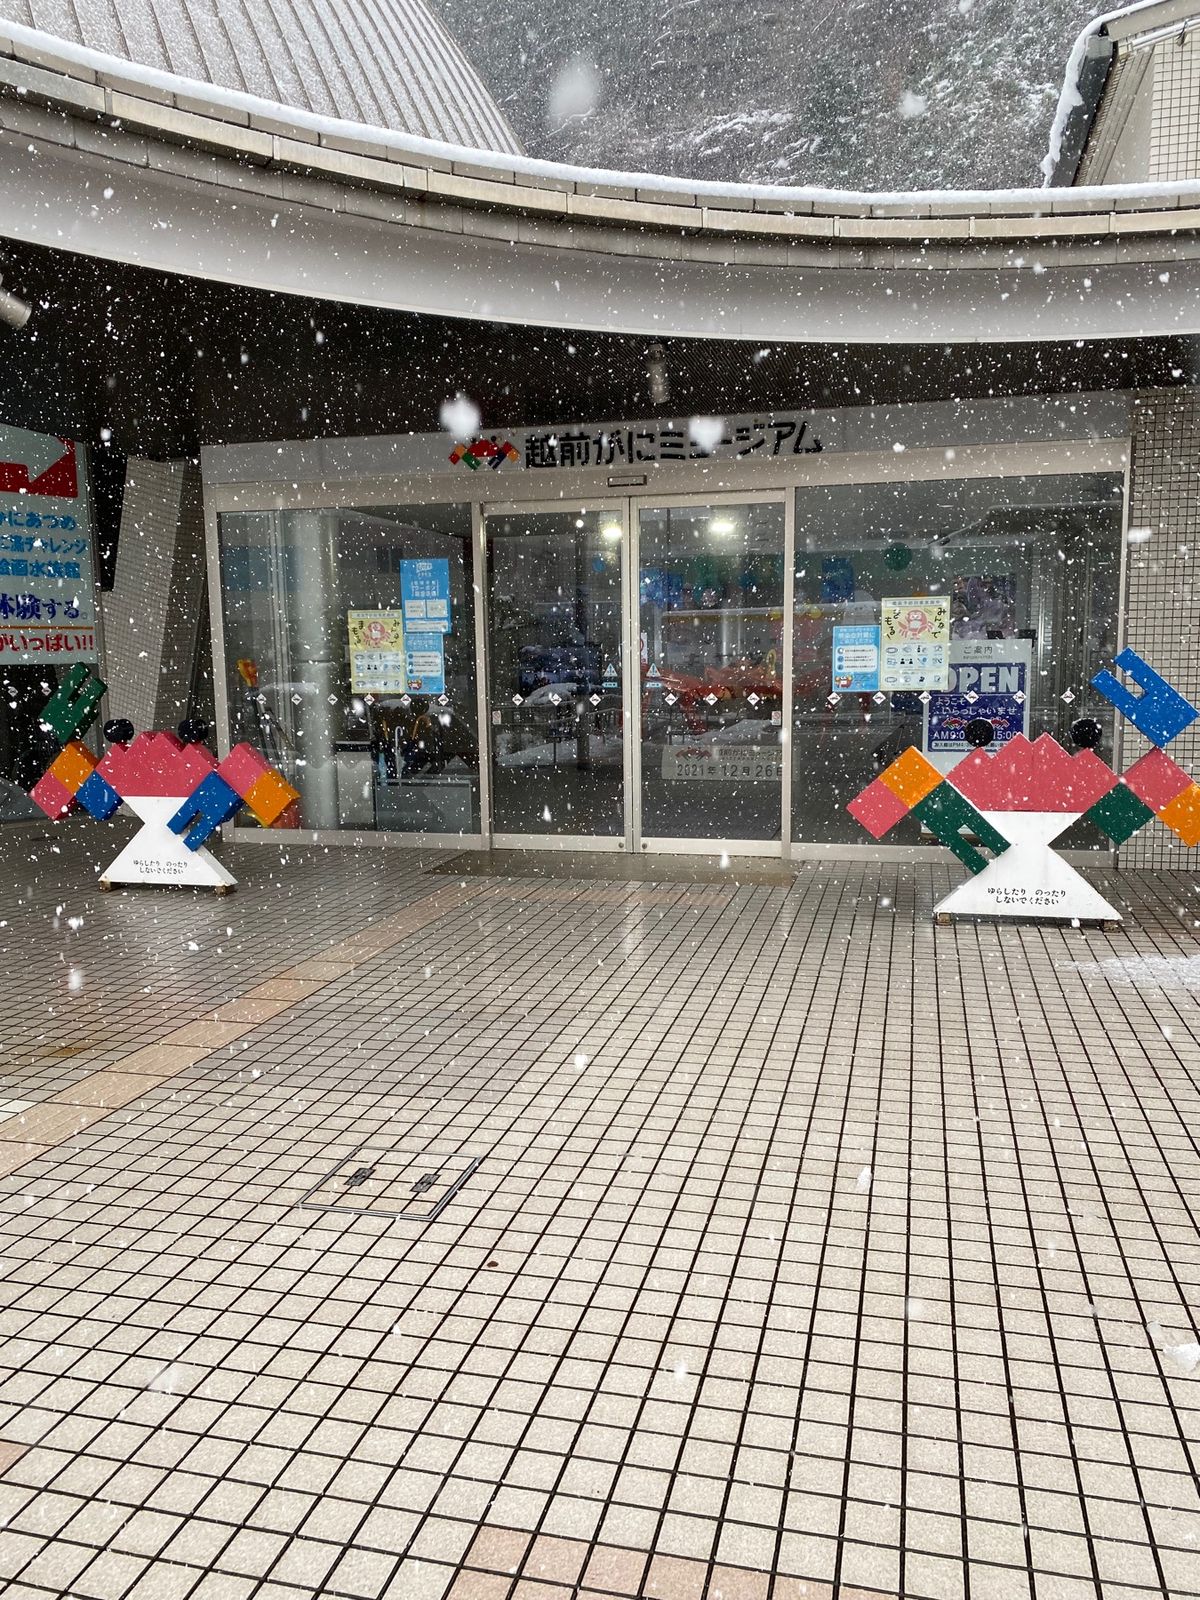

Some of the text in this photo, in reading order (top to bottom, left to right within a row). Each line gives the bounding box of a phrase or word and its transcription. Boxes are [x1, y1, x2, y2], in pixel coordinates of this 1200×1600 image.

[932, 607, 946, 638] みんなで
[963, 645, 993, 655] ご案内
[936, 698, 966, 706] ようこそ
[942, 706, 1017, 716] いらっしゃいませ
[140, 867, 184, 875] しないでください
[987, 887, 1066, 898] ゆらしたり のったり
[995, 896, 1059, 906] しないでください
